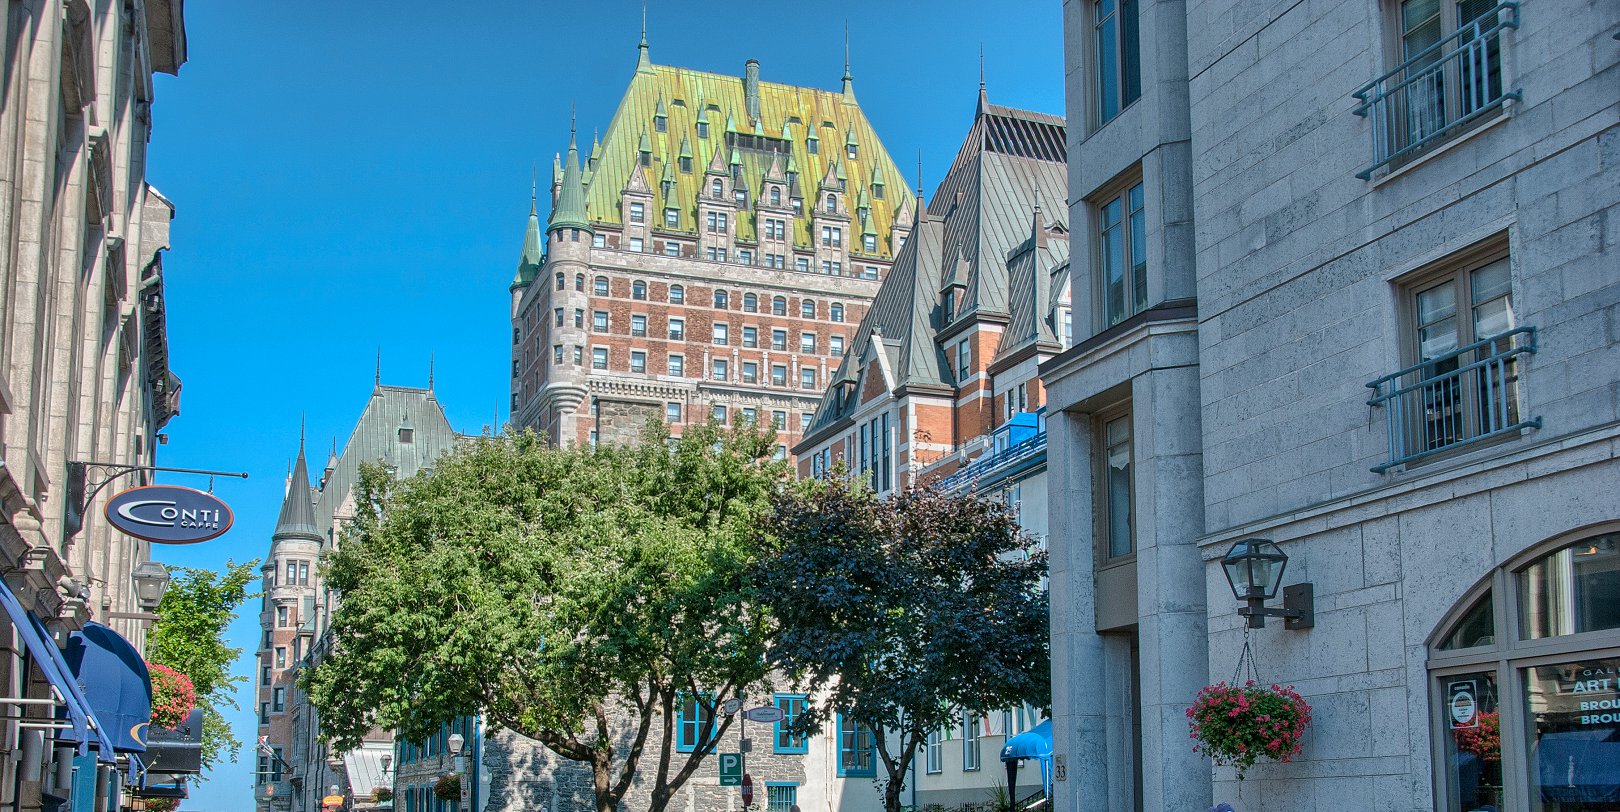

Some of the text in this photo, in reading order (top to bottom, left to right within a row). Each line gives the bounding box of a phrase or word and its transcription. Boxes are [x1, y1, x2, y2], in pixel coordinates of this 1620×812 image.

[1583, 666, 1620, 676] GAL
[1573, 678, 1612, 694] ART
[1580, 699, 1620, 711] BROU
[1581, 713, 1620, 725] BROU
[723, 755, 738, 774] P
[1055, 765, 1066, 779] 33
